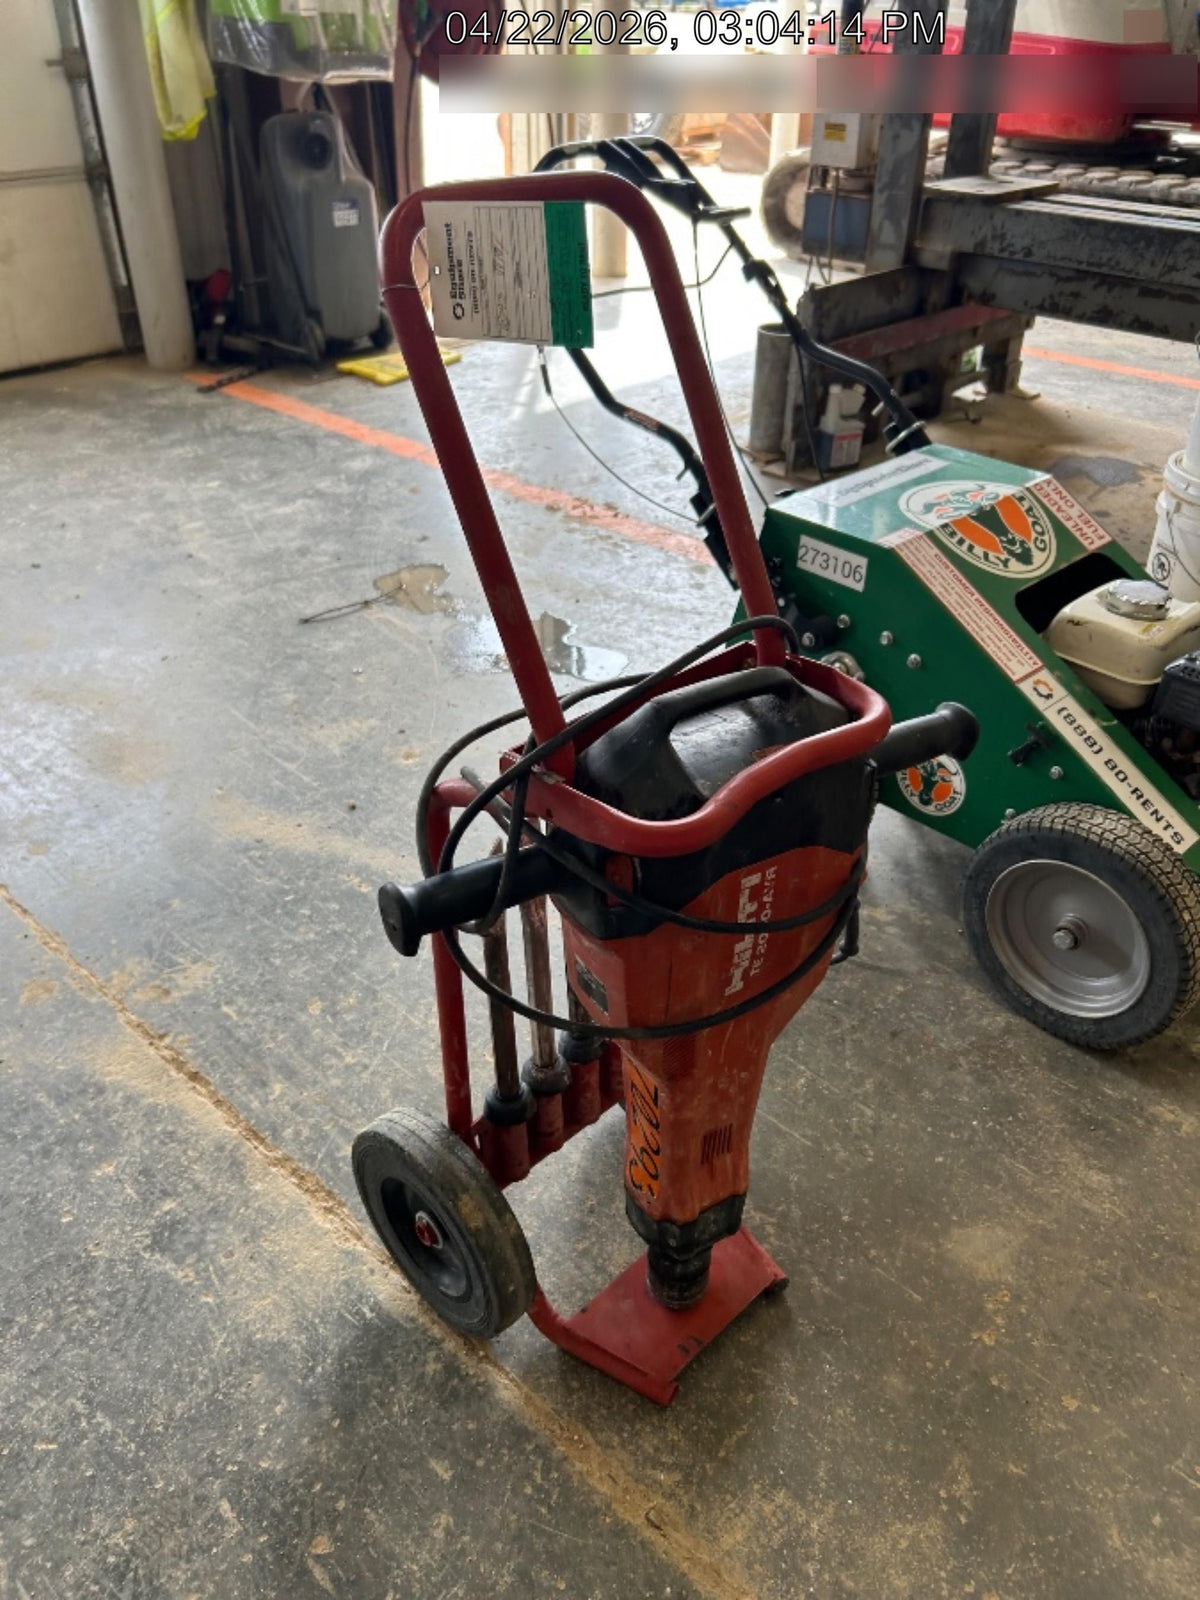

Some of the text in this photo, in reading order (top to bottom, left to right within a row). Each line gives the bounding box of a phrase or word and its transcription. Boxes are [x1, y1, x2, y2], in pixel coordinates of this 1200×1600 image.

[941, 492, 1048, 569] BILLY GOAT
[1033, 482, 1096, 547] UNLEADED
[1045, 480, 1105, 541] FUEL ONLY
[798, 543, 864, 585] 273106
[1057, 706, 1185, 845] (888) 80-RENTS
[756, 865, 778, 956] 200-AVR
